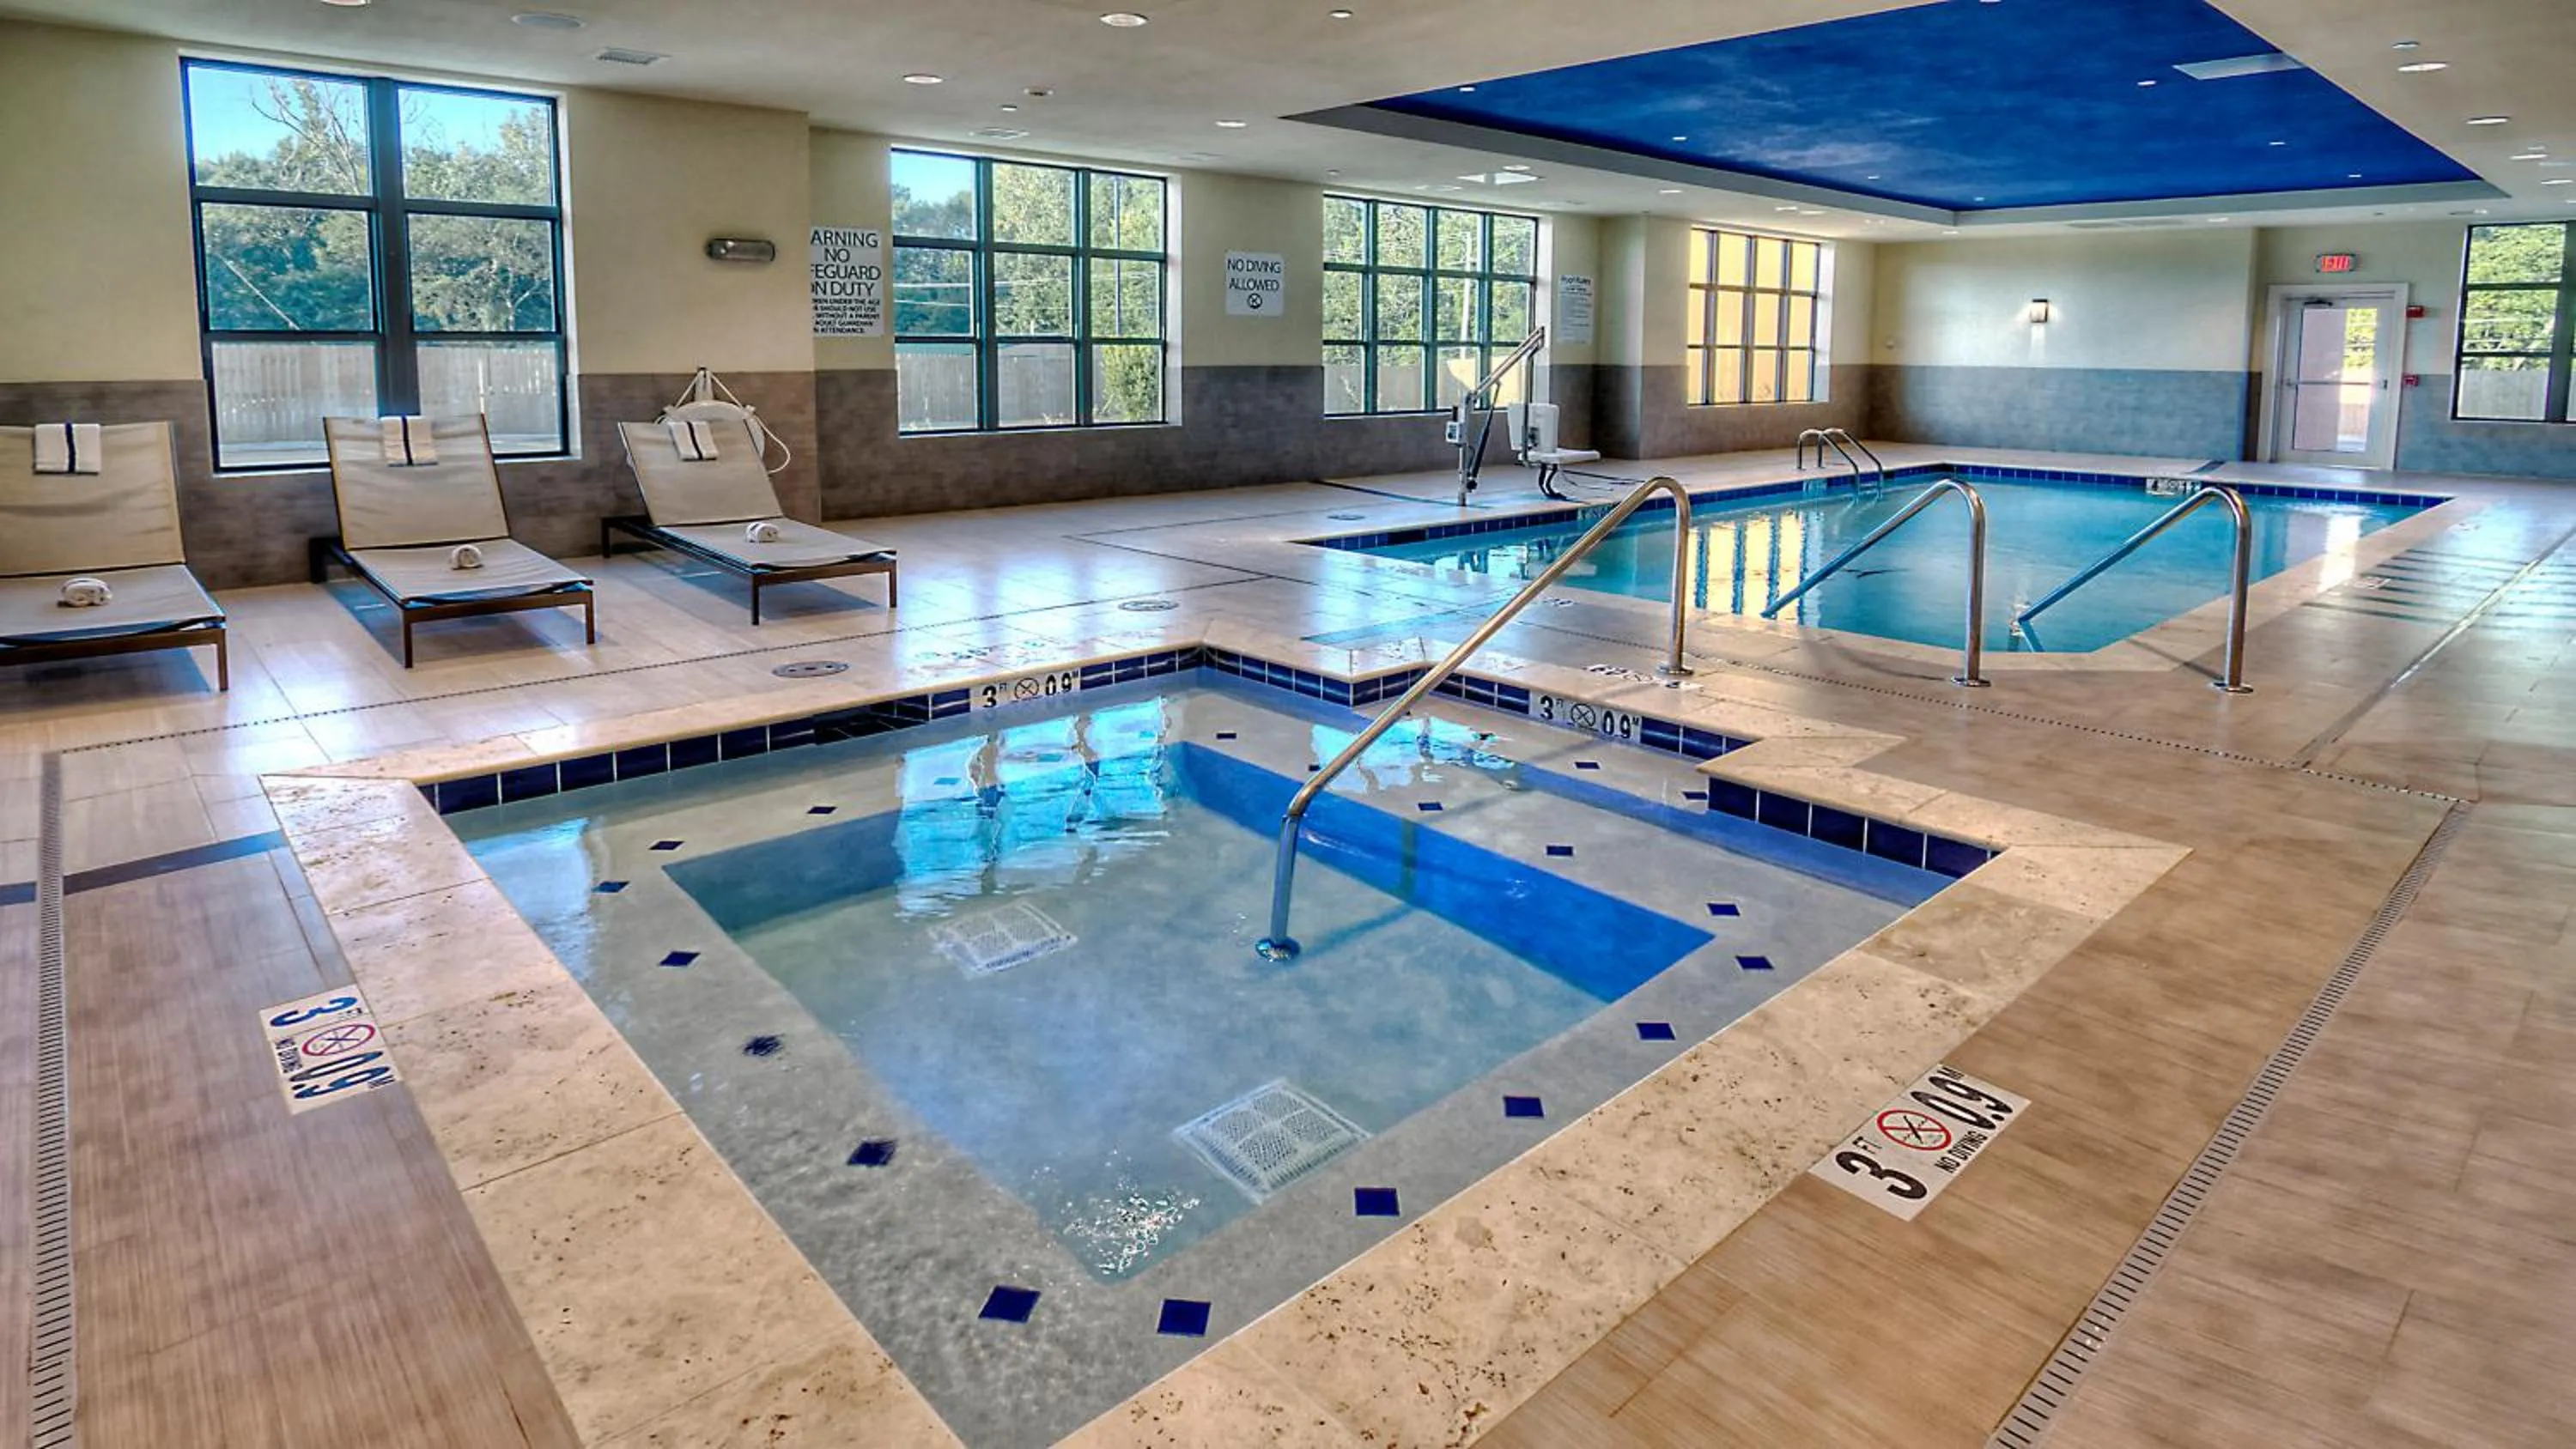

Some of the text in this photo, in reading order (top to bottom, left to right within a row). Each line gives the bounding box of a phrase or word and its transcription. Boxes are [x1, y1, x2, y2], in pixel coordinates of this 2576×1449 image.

[811, 229, 878, 248] ARNING
[823, 247, 851, 264] NO
[1227, 258, 1281, 274] NO DIVING
[811, 264, 882, 281] EGUARD
[830, 281, 875, 296] DUTY
[1229, 277, 1279, 291] ALLOWED
[981, 684, 998, 708] 3
[1540, 694, 1553, 720] 3
[270, 997, 358, 1027] 3
[289, 1050, 391, 1100] 0.9
[1835, 1150, 1928, 1200] 3
[1909, 1075, 2014, 1131] 0.9
[1934, 1131, 1990, 1174] NO DIVING
